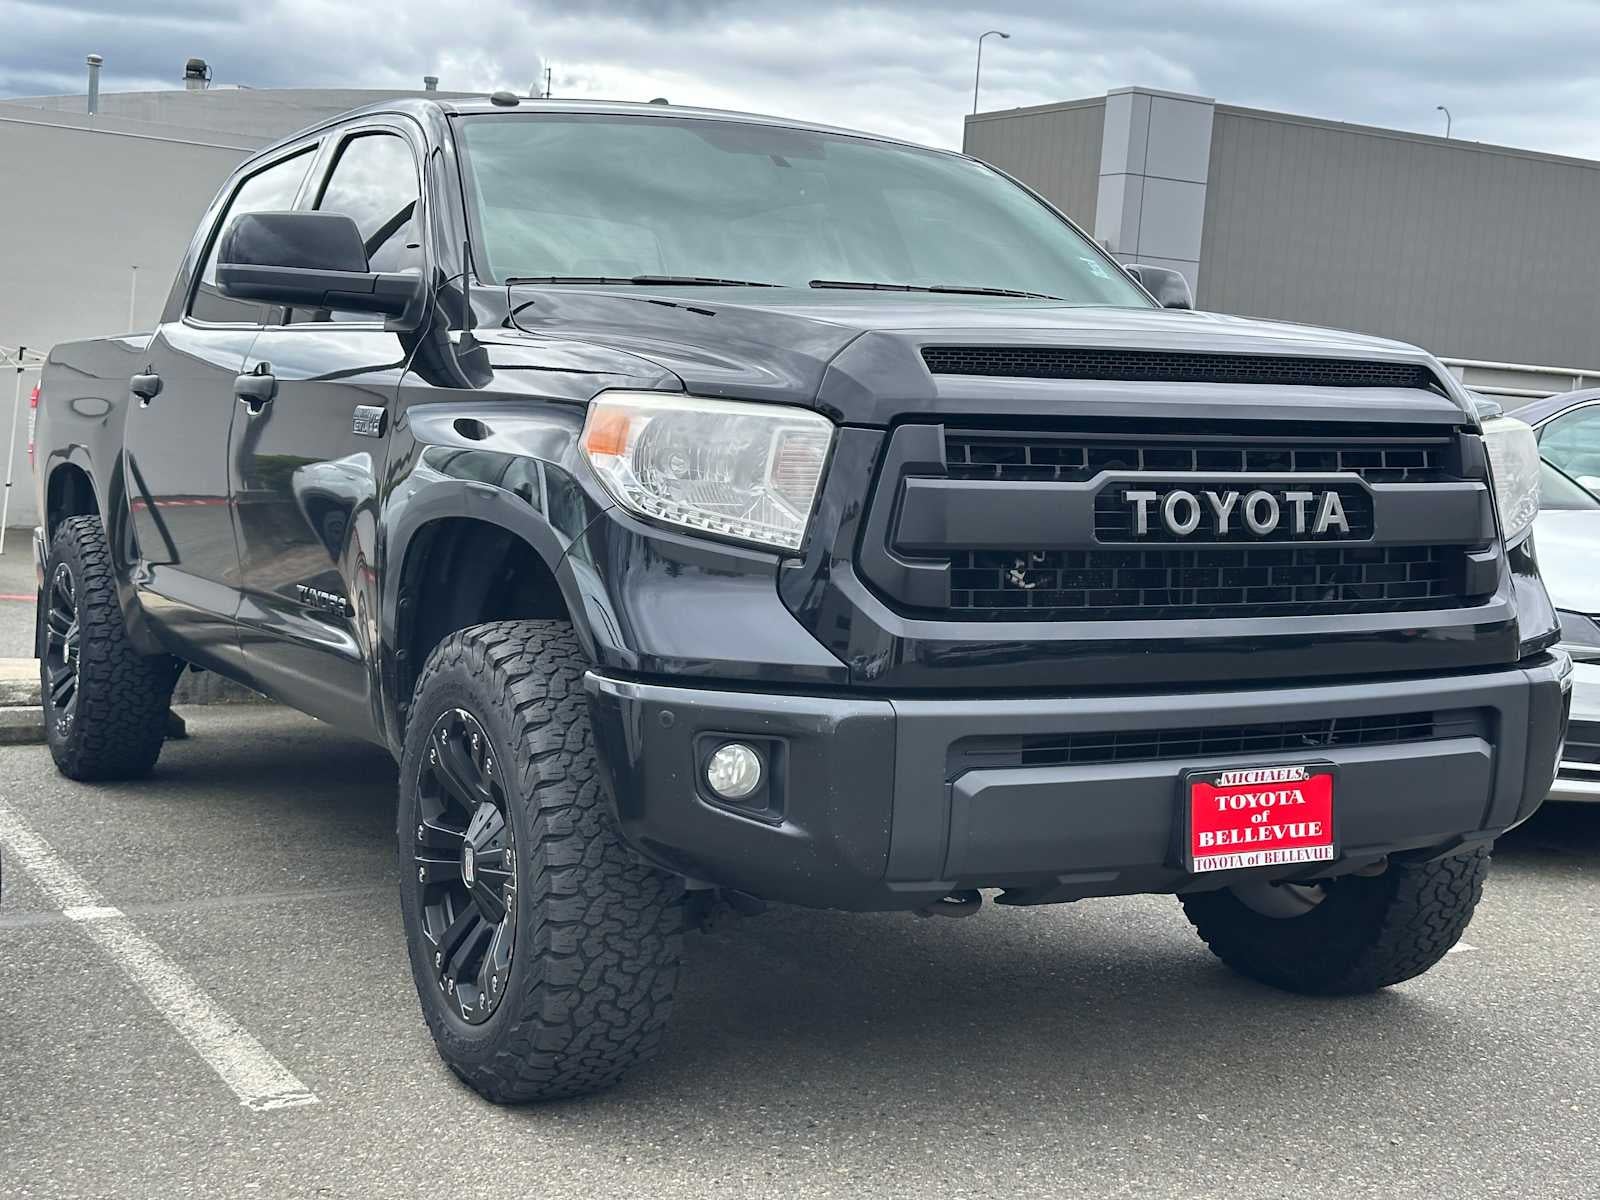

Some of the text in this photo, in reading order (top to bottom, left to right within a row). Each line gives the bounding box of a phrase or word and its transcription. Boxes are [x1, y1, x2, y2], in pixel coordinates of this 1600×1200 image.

[1122, 489, 1350, 536] TOYOTA
[1222, 767, 1304, 785] MICHAELS
[1214, 789, 1306, 811] TOYOTA
[1251, 810, 1270, 824] of
[1198, 821, 1323, 847] BELLEVUE
[1195, 846, 1333, 872] TOYOTA of BELLEVUE
